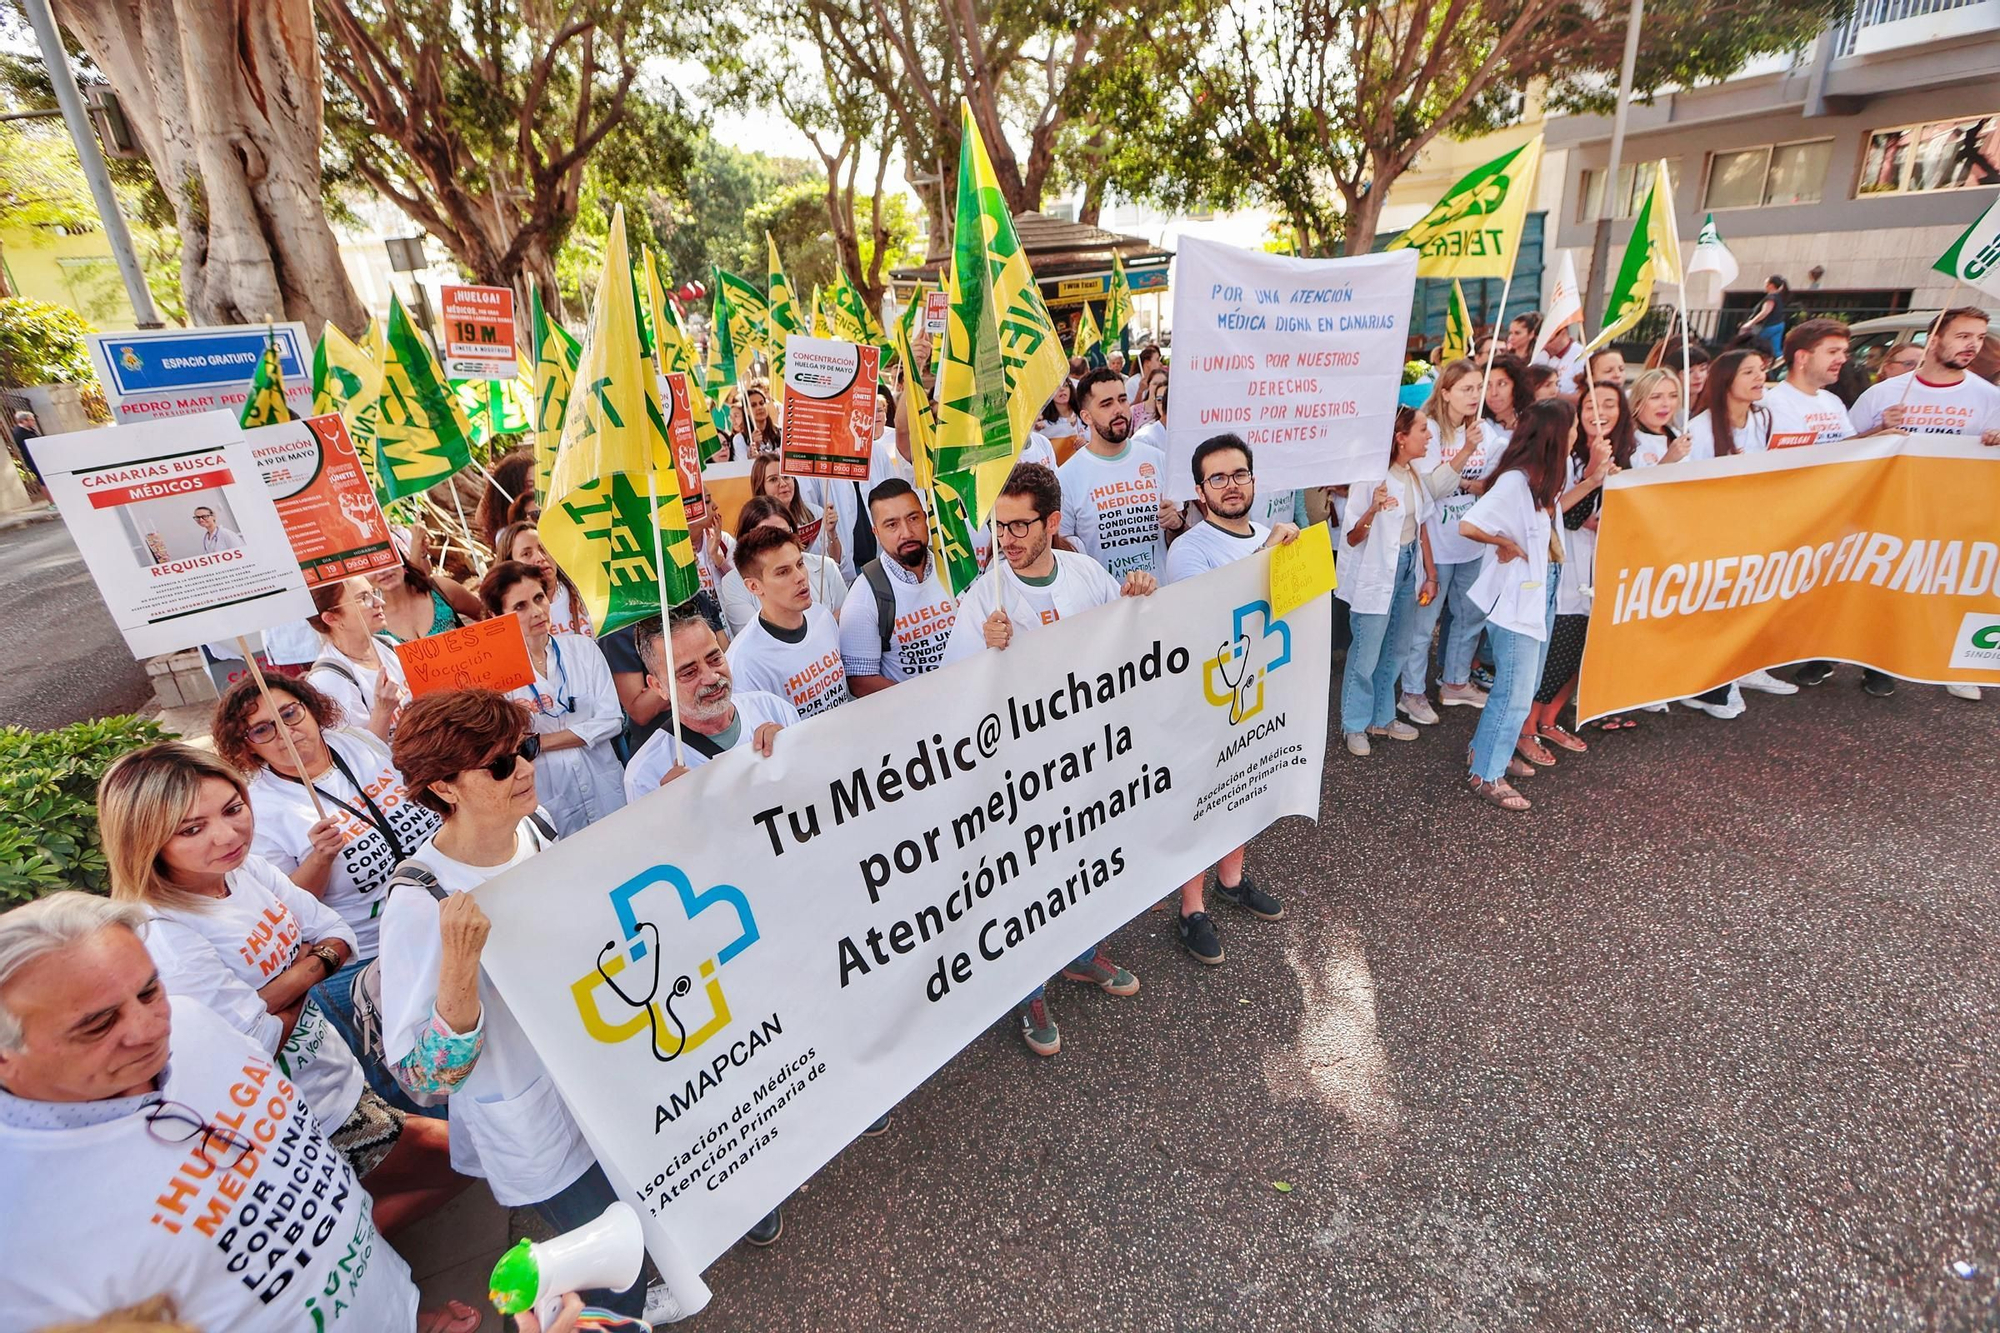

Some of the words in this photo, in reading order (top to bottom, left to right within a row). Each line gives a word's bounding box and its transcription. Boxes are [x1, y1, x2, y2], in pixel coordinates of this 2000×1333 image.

[454, 290, 501, 304] ¡HUELGA!
[1212, 284, 1243, 302] POR
[1254, 289, 1280, 305] UNA
[1290, 282, 1354, 305] ATENCIÓN
[455, 322, 476, 342] 19
[1217, 307, 1266, 331] MÉDICA
[1275, 316, 1312, 332] DIGNA
[1318, 317, 1334, 333] EN
[1340, 314, 1395, 331] CANARIAS
[162, 356, 209, 370] ESPACIO
[210, 352, 257, 366] GRATUITO
[792, 352, 855, 367] CONCENTRACIÓN
[794, 361, 819, 370] HUELGA
[836, 366, 854, 374] MAYO
[1266, 353, 1290, 369] POR
[1296, 352, 1360, 367] NUESTROS
[221, 394, 247, 405] PED
[1248, 378, 1323, 397] DERECHOS,
[121, 400, 171, 415] PEDRO
[1200, 407, 1251, 425] UNIDOS
[1260, 404, 1288, 420] POR
[1294, 400, 1360, 419] NUESTROS,
[252, 440, 313, 459] ENTRACIÓN
[266, 458, 274, 466] 19
[276, 455, 288, 463] DE
[290, 450, 315, 461] MAYO
[82, 465, 169, 488] CANARIAS
[173, 454, 227, 473] BUSCA
[128, 477, 204, 500] MÉDICOS
[1090, 479, 1158, 502] ¡HUELGA!
[1096, 493, 1157, 512] MÉDICOS
[1099, 510, 1122, 521] POR
[1127, 504, 1159, 515] UNAS
[1100, 524, 1159, 540] LABORALES
[1100, 533, 1159, 550] DIGNAS
[151, 550, 244, 577] REQUISITOS
[325, 564, 337, 574] 19
[1115, 571, 1121, 579] A
[1612, 542, 1833, 626] ¡ACUERDOS
[898, 615, 956, 644] MÉDICO
[901, 639, 930, 652] POR
[935, 630, 952, 642] UN
[402, 640, 440, 664] NO
[443, 627, 480, 654] ES
[898, 641, 946, 658] CONDICI
[414, 651, 493, 683] Vocación
[902, 665, 940, 675] DIG
[794, 666, 844, 707] MÉDICOS
[797, 698, 823, 718] POR
[824, 684, 844, 701] UNA
[753, 805, 821, 857] Tu
[830, 713, 1002, 827] Médic@
[1008, 640, 1191, 741] luchando
[1216, 712, 1286, 768] AMAPCAN
[1196, 766, 1246, 808] Asociación
[1247, 762, 1259, 776] de
[1260, 743, 1303, 767] Médicos
[1193, 807, 1205, 822] de
[1206, 780, 1247, 814] Atención
[1249, 760, 1289, 787] Primaria
[1292, 756, 1307, 766] de
[1227, 783, 1268, 812] Canarias
[859, 827, 941, 904] por
[954, 738, 1098, 851] mejorar
[1104, 723, 1133, 764] la
[343, 832, 381, 861] POR
[837, 856, 1021, 988] Atención
[1024, 762, 1173, 867] Primaria
[926, 946, 973, 1002] de
[978, 846, 1126, 962] Canarias
[297, 1056, 308, 1070] A
[654, 1012, 784, 1135] AMAPCAN
[731, 1101, 752, 1124] de
[752, 1046, 817, 1106] Médicos
[660, 1137, 738, 1211] Atención
[739, 1078, 807, 1142] Primaria
[807, 1061, 828, 1083] de
[192, 1079, 295, 1240] MÉDICOS
[705, 1126, 780, 1192] Canarias
[217, 1180, 277, 1254] POR
[272, 1098, 310, 1169] UNAS
[242, 1152, 337, 1291] LABORAL
[259, 1163, 351, 1305] DIGNA
[334, 1300, 349, 1319] A
